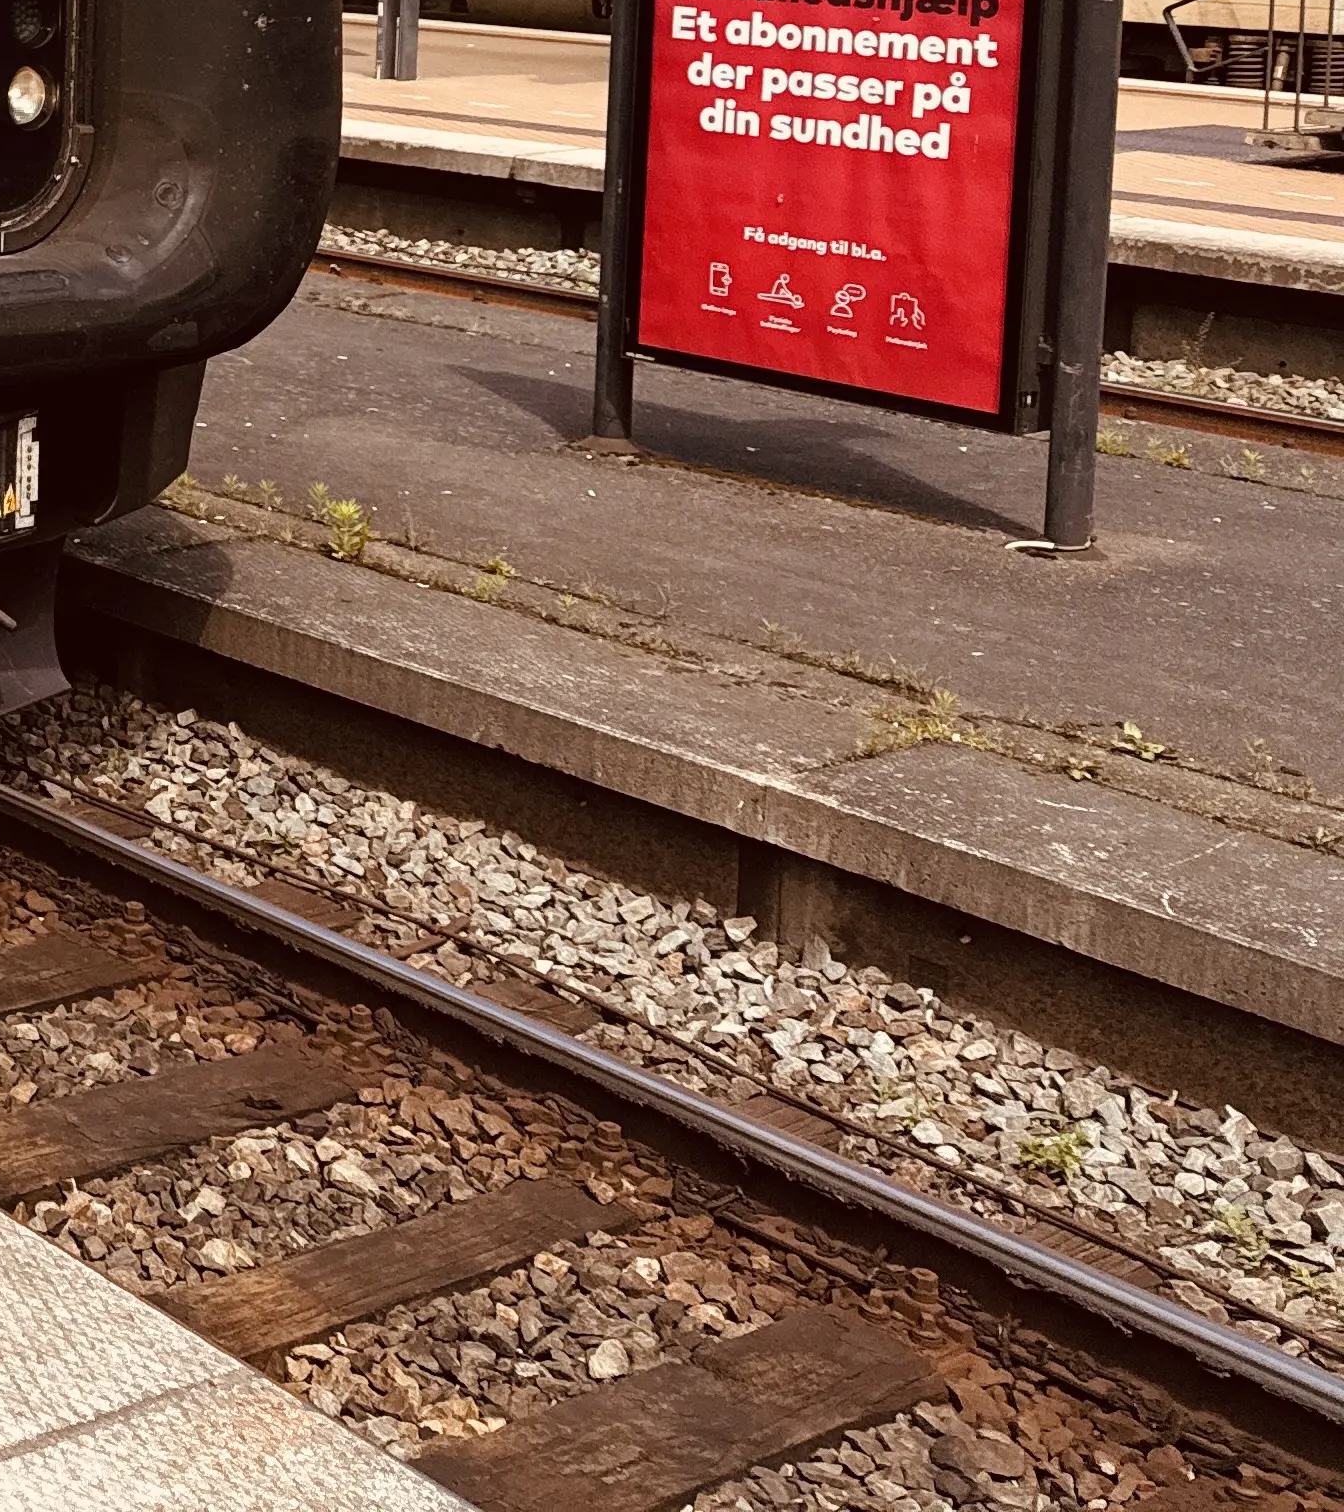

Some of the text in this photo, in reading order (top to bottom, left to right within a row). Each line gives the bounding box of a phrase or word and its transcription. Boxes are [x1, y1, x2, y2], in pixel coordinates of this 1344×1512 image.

[671, 6, 999, 68] Et abonnement
[687, 52, 972, 118] der passer på
[699, 98, 951, 160] din sundhed
[743, 226, 887, 262] Få adgang til bl.a.
